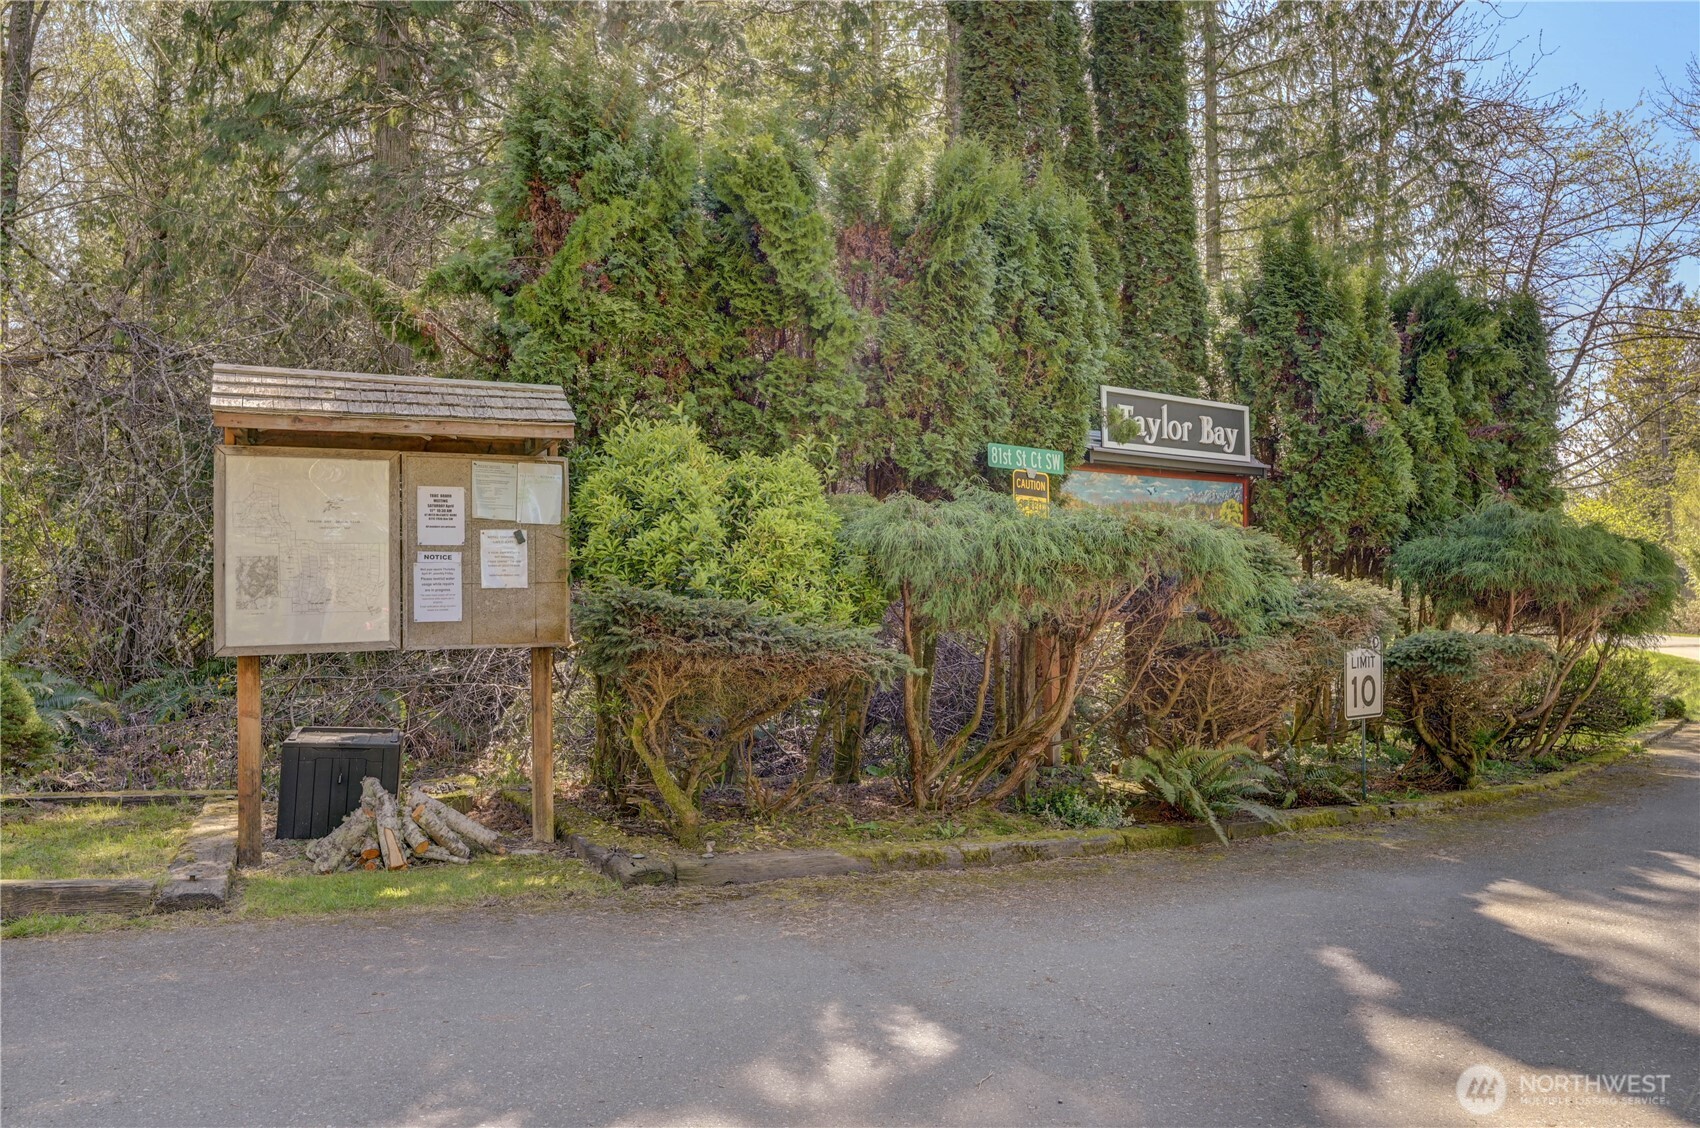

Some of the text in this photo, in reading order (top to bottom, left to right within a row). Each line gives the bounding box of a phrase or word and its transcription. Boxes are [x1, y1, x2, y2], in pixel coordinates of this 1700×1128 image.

[1117, 403, 1239, 453] Taylor Bay
[991, 446, 1060, 471] 81st St Ct SW
[1016, 478, 1046, 491] CAUTION
[1351, 655, 1375, 669] LIMIT
[1351, 674, 1376, 708] 10
